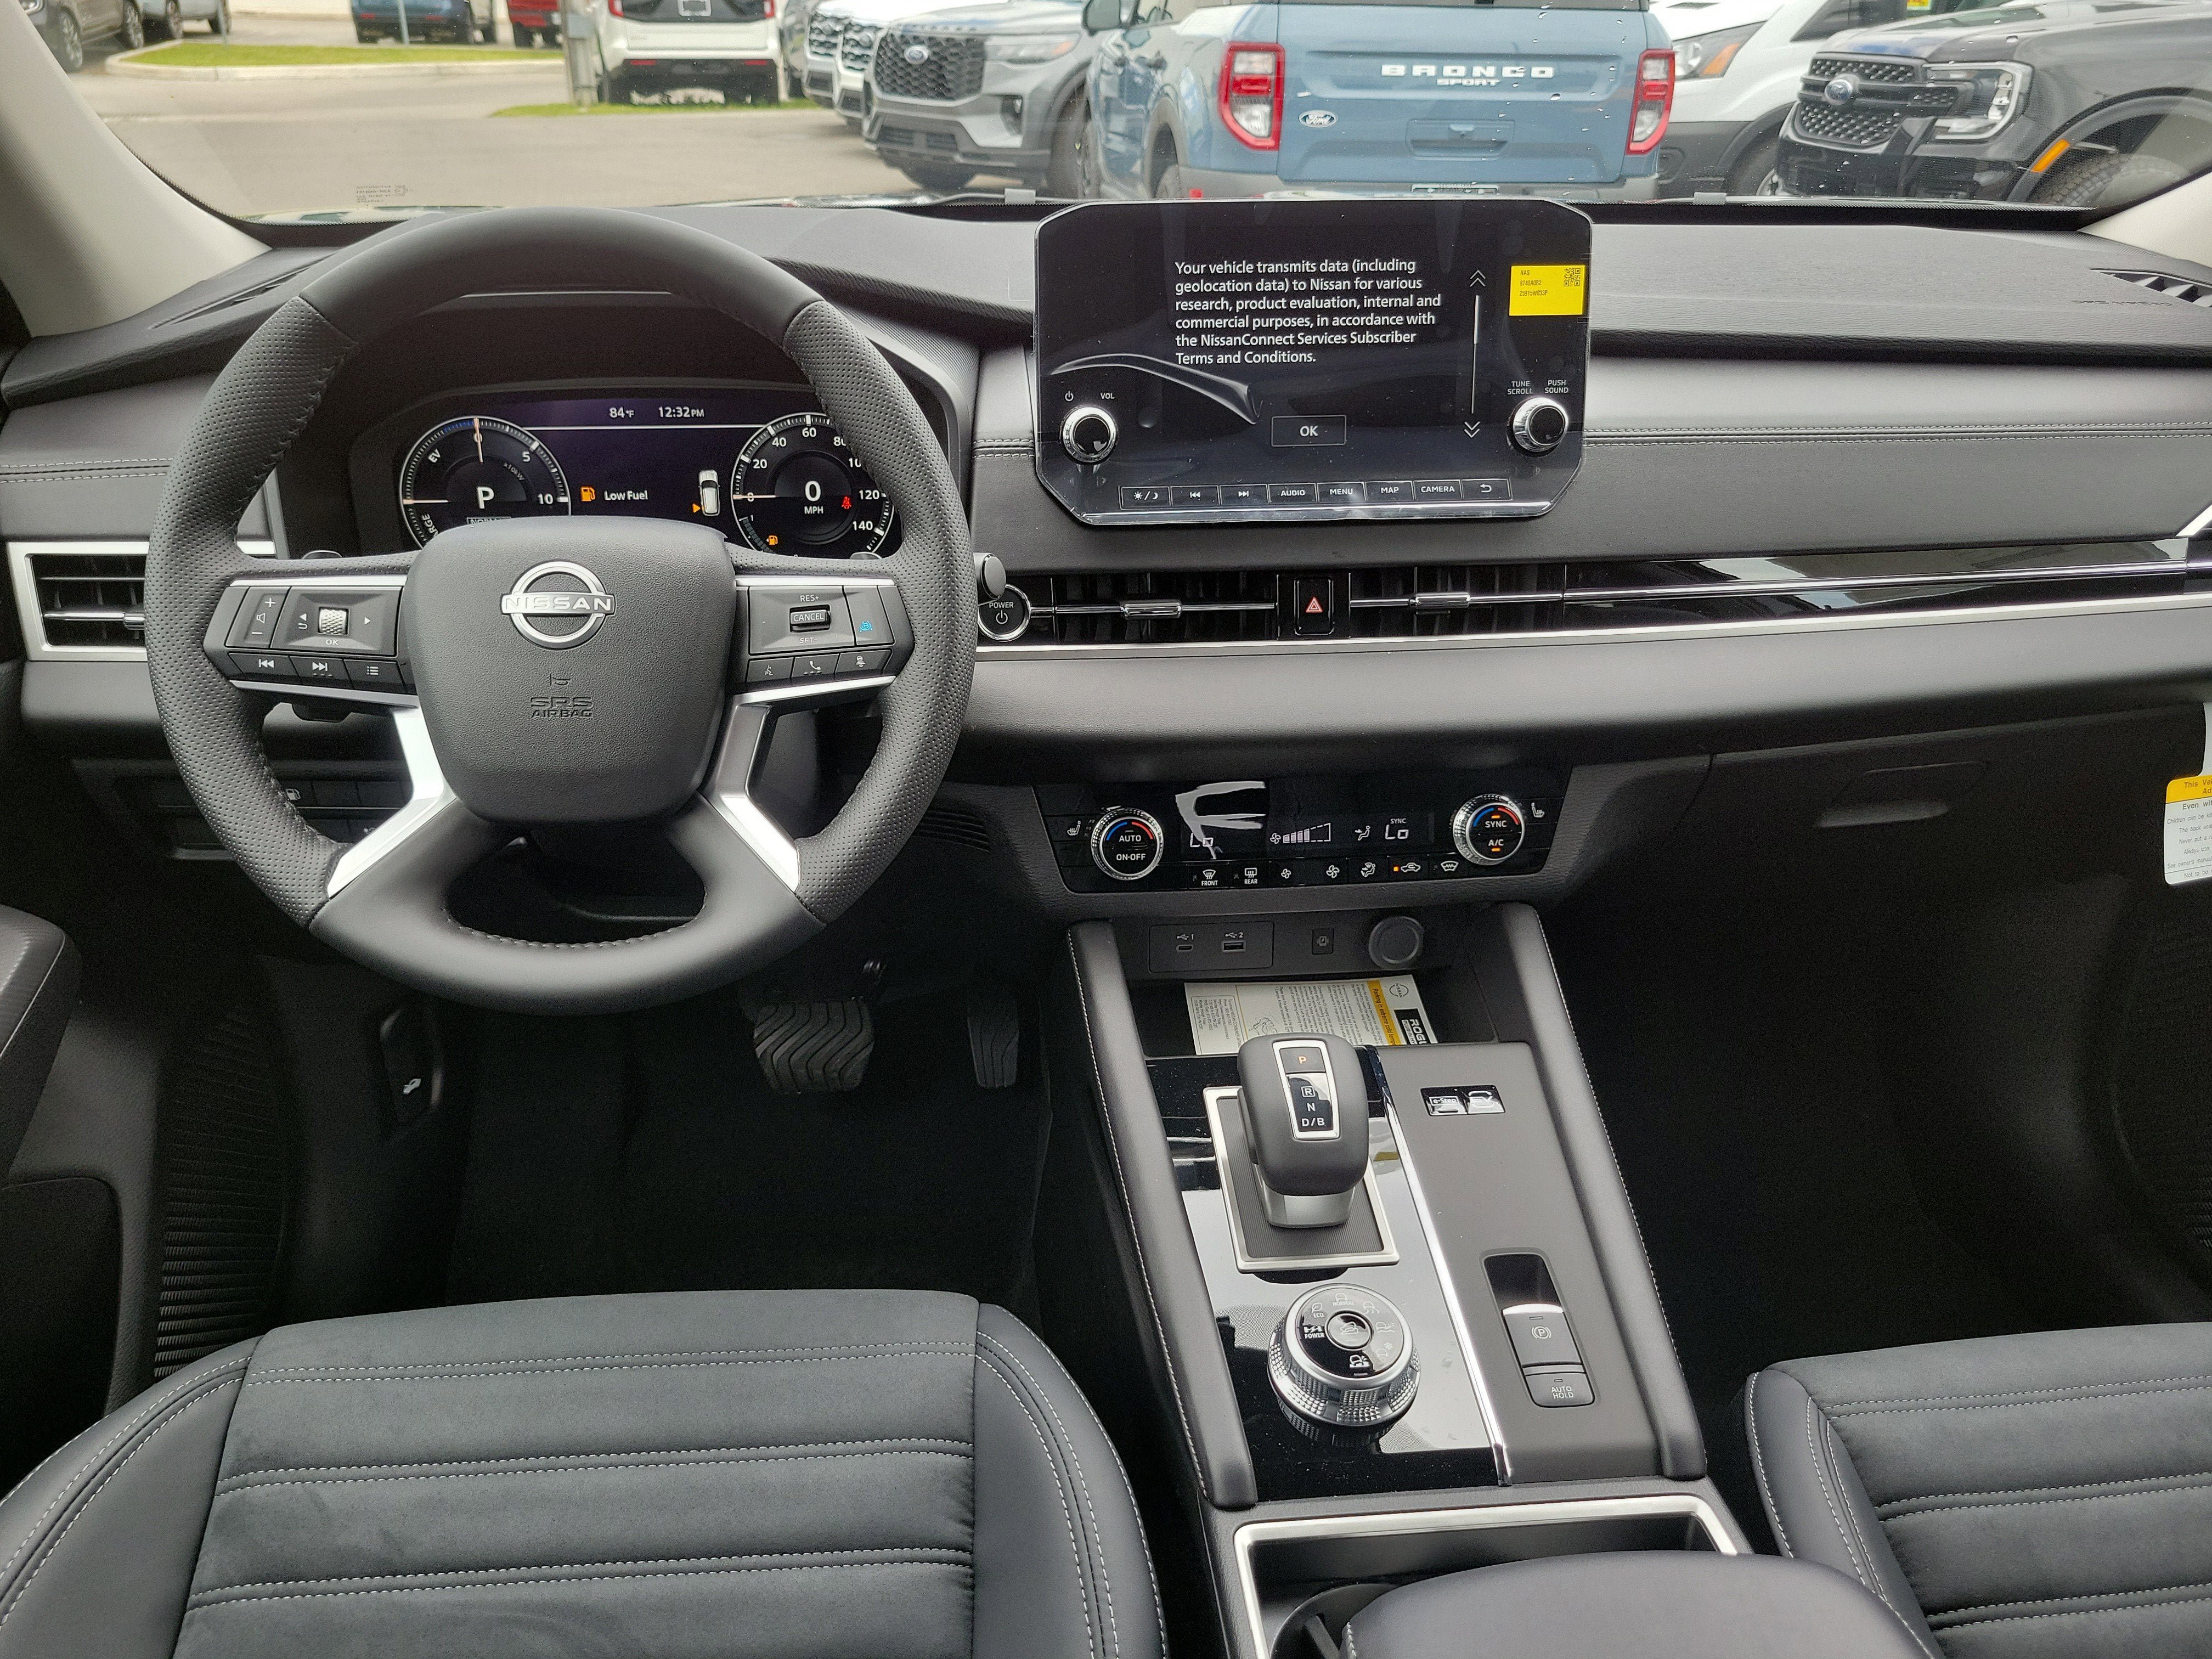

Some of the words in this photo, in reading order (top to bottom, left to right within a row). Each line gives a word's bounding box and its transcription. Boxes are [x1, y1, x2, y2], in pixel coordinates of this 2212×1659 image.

[1381, 64, 1554, 78] BRONCO
[1436, 78, 1500, 87] SPORT
[1175, 262, 1206, 274] Your
[1209, 261, 1254, 274] vehicle
[1256, 260, 1316, 273] transmits
[1319, 259, 1348, 272] data
[1352, 258, 1415, 274] (including
[1175, 279, 1252, 295] geolocation
[1255, 278, 1289, 293] data)
[1292, 280, 1306, 291] to
[1310, 278, 1351, 290] Nissan
[1354, 277, 1374, 290] for
[1376, 277, 1423, 289] various
[1176, 297, 1233, 312] research,
[1236, 296, 1287, 312] product
[1289, 296, 1360, 309] evaluation,
[1364, 294, 1413, 308] internal
[1416, 294, 1442, 307] and
[1176, 315, 1249, 329] commercial
[1252, 317, 1313, 330] purposes,
[1317, 314, 1328, 326] in
[1331, 313, 1403, 326] accordance
[1406, 312, 1435, 325] with
[1175, 334, 1197, 347] the
[1201, 334, 1295, 347] NissanConnect
[1297, 332, 1347, 345] Services
[1350, 330, 1417, 344] Subscriber
[1176, 352, 1213, 364] Terms
[1216, 351, 1241, 364] and
[1244, 350, 1316, 363] Conditions.
[802, 427, 817, 438] 60
[1300, 426, 1318, 437] OK
[771, 437, 787, 447] 40
[427, 448, 441, 464] EV
[522, 451, 531, 462] 5
[753, 459, 768, 469] 20
[604, 490, 625, 500] Low
[627, 490, 648, 500] Fuel
[805, 481, 821, 501] 0
[859, 490, 879, 500] 120
[477, 486, 494, 509] P
[538, 493, 554, 505] 10
[804, 506, 823, 514] MPH
[852, 521, 873, 531] 140
[505, 596, 611, 611] NISSAN
[793, 613, 823, 622] CANCEL
[531, 697, 594, 709] SRS
[531, 709, 593, 718] AIRBAG
[1307, 1103, 1316, 1111] N
[1301, 1118, 1325, 1126] D/B
